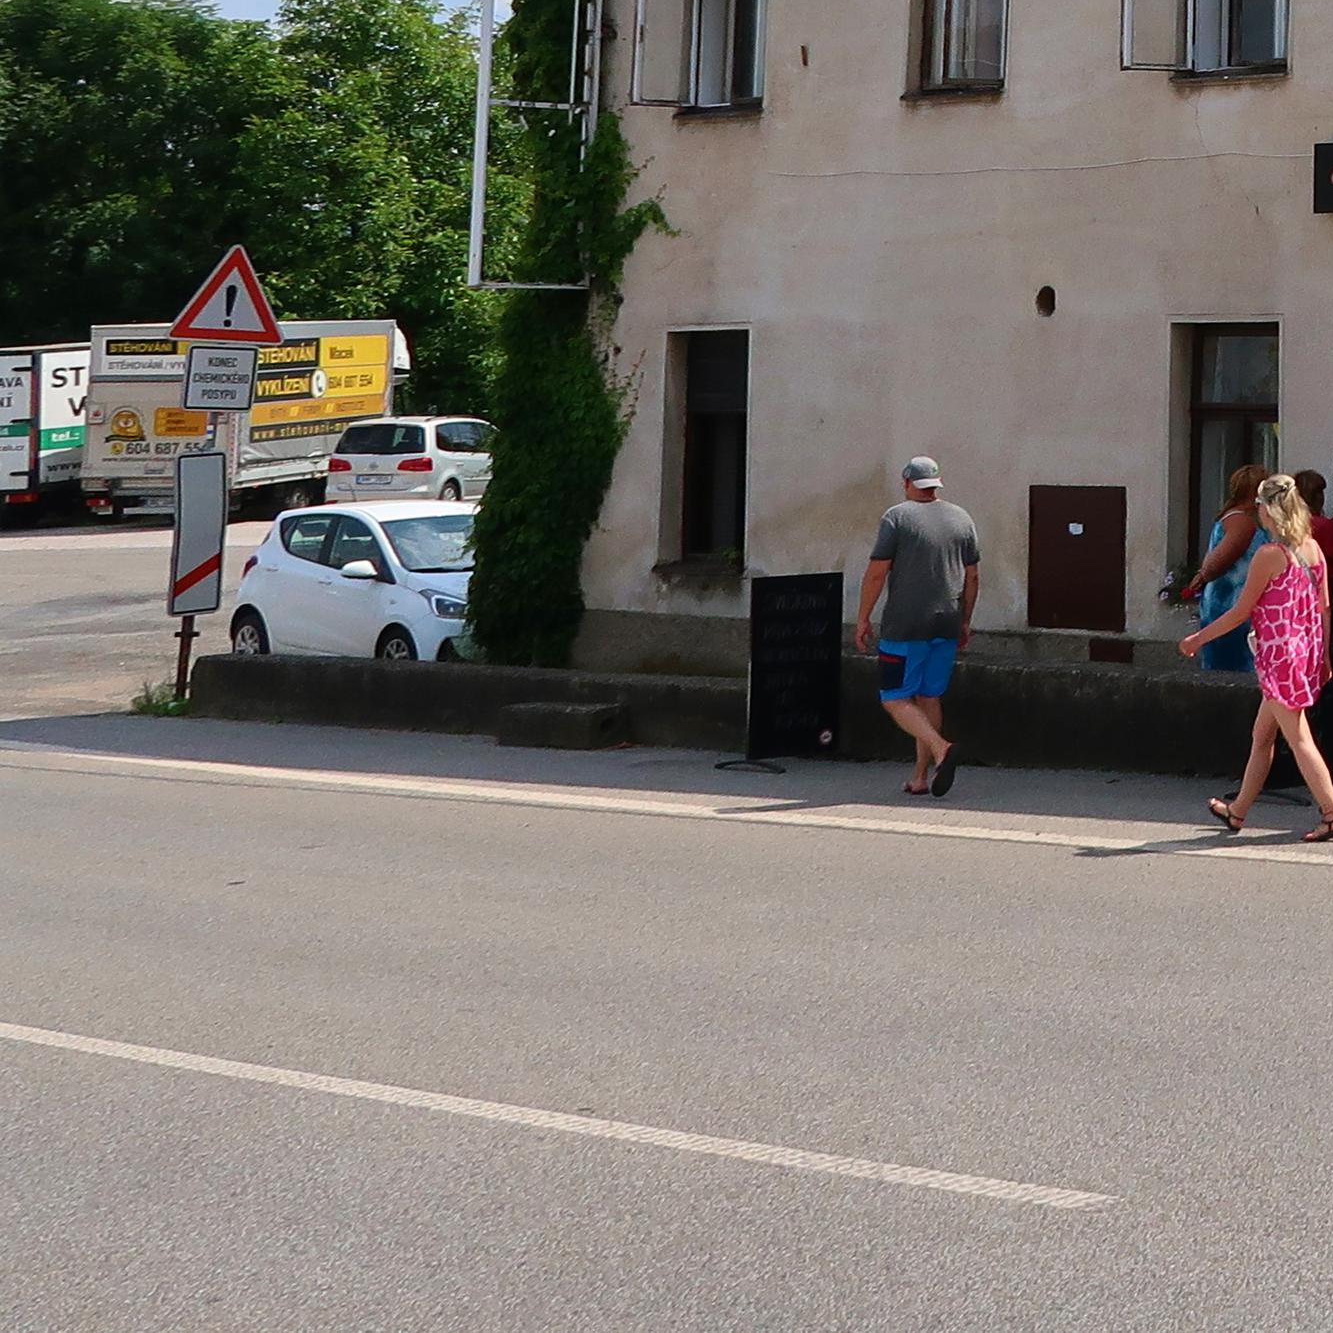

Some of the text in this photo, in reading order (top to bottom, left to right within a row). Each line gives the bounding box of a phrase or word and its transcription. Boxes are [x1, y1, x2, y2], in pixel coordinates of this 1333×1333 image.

[207, 356, 238, 368] KONEC
[192, 371, 250, 384] CHEMICKÉHO
[256, 373, 311, 397] VYKLÍZENÍ
[201, 388, 237, 400] POSYPU
[126, 442, 151, 455] 604
[155, 442, 180, 455] 687
